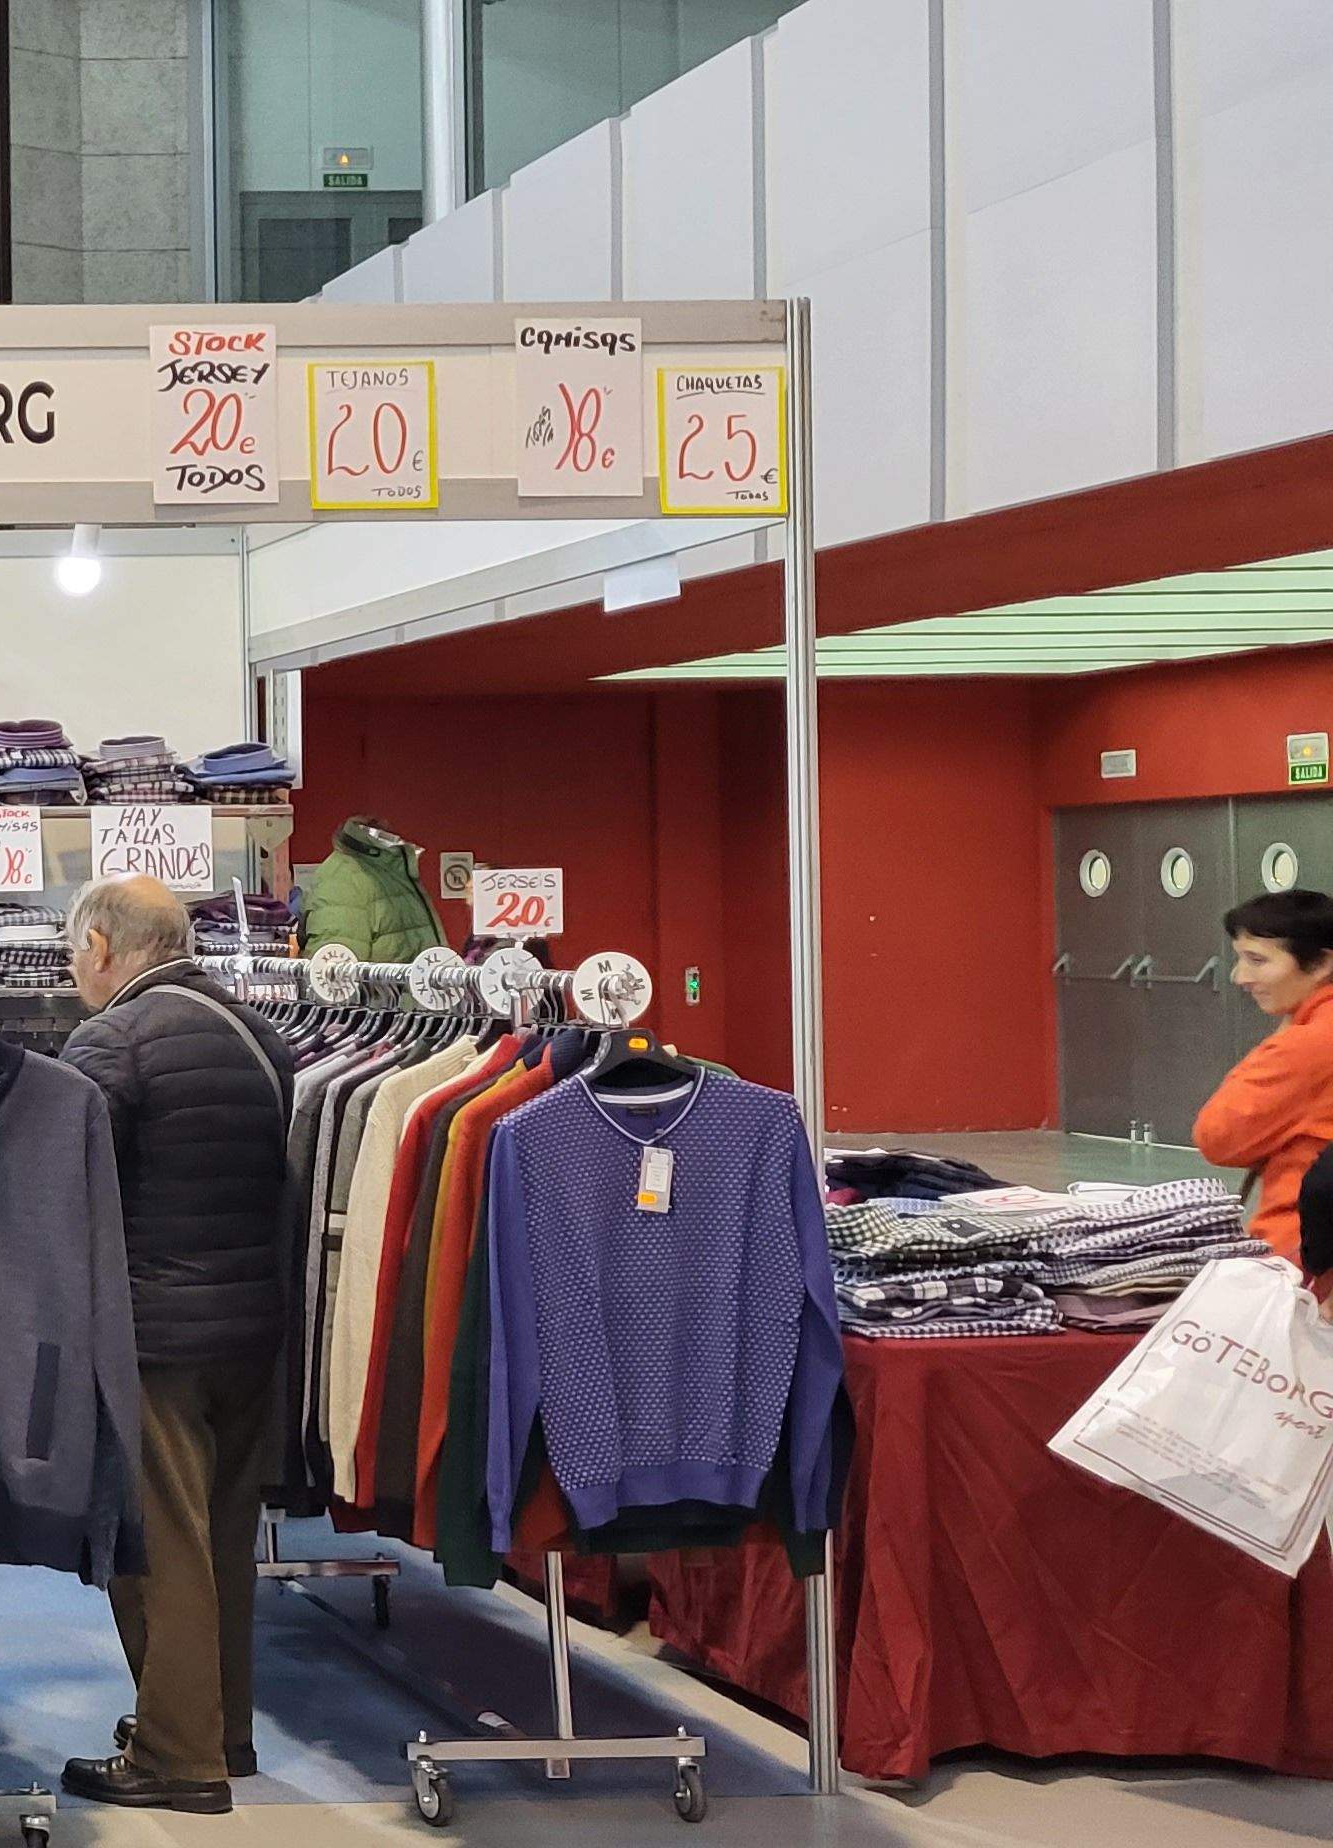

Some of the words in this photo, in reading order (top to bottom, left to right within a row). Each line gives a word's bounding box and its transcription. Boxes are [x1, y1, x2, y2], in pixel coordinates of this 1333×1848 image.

[329, 175, 363, 186] SALIDA
[169, 331, 265, 355] STOCK
[158, 360, 270, 391] JERSEY
[326, 369, 408, 388] TEJANOS
[676, 375, 763, 395] CHAQUETAS
[167, 465, 265, 492] TODOS
[372, 487, 422, 498] TODOS
[1295, 765, 1323, 780] SALIDA
[119, 808, 161, 827] HAY
[99, 824, 175, 845] TALLAS
[101, 843, 211, 880] GRANDES
[482, 872, 556, 891] JERSEIS
